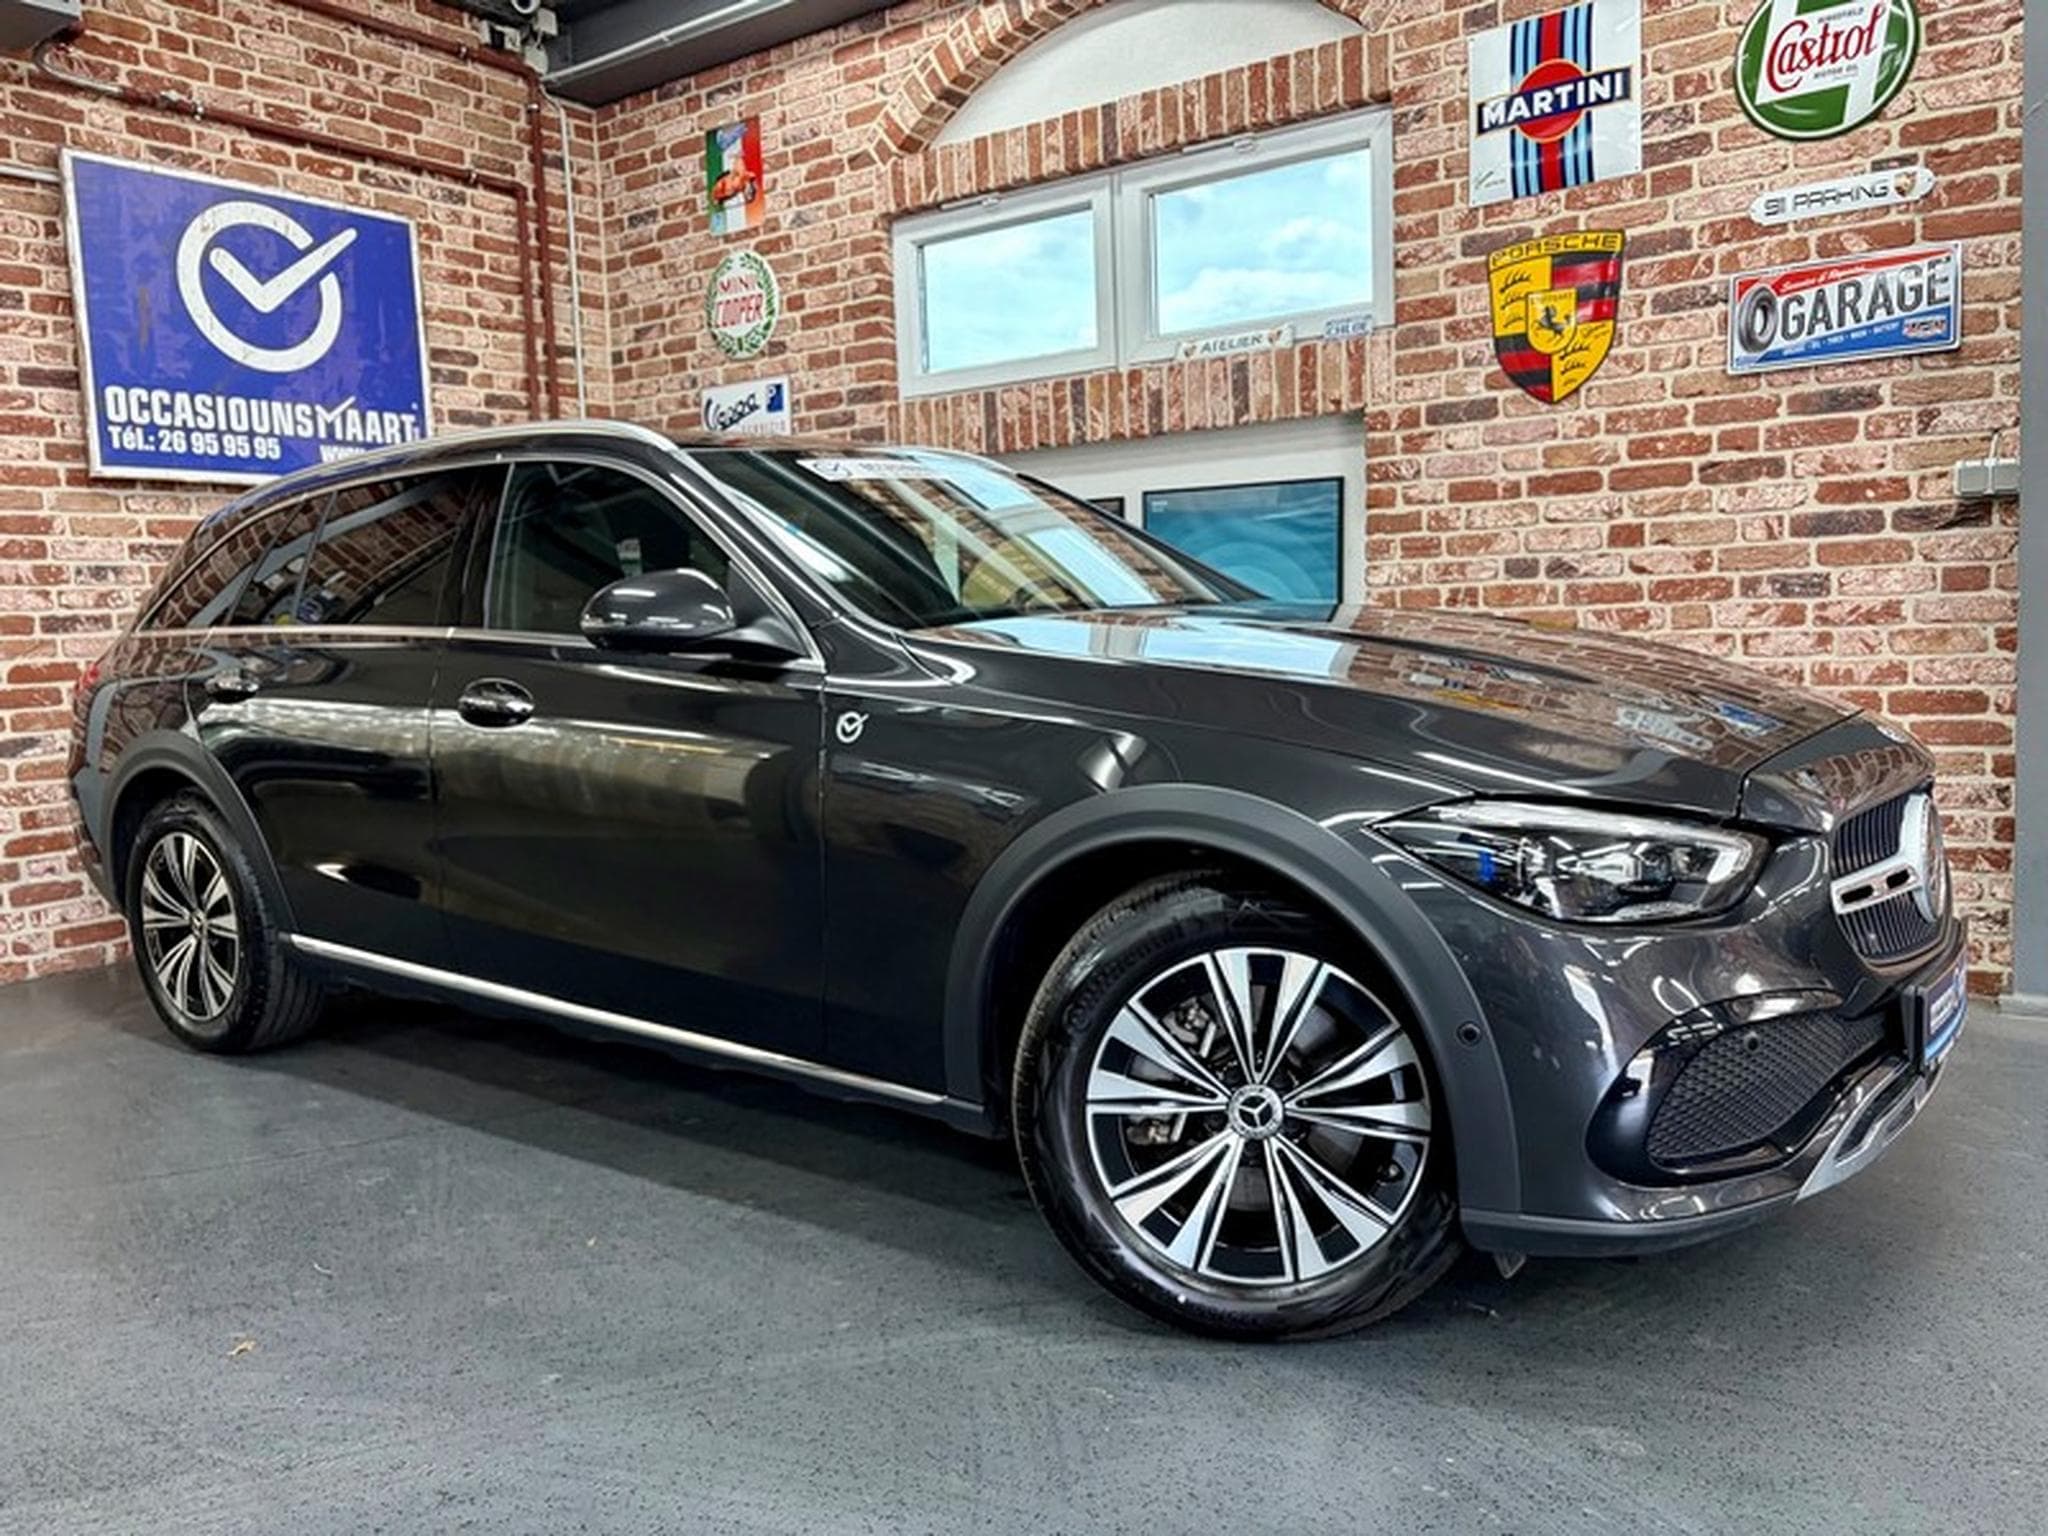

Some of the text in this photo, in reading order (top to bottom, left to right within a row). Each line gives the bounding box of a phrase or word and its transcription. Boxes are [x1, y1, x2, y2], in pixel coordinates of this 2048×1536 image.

[1766, 3, 1887, 93] Castrol
[1482, 72, 1623, 130] MARTINI
[1792, 179, 1889, 211] PARKING
[1491, 234, 1619, 267] PORSCHE
[715, 292, 764, 329] COOPER
[1780, 255, 1952, 341] GARAGE
[1199, 333, 1264, 354] ATELIER
[704, 392, 761, 432] Vespa
[157, 429, 187, 454] 26
[190, 432, 219, 456] 95
[223, 435, 250, 459] 95
[254, 437, 282, 461] 95
